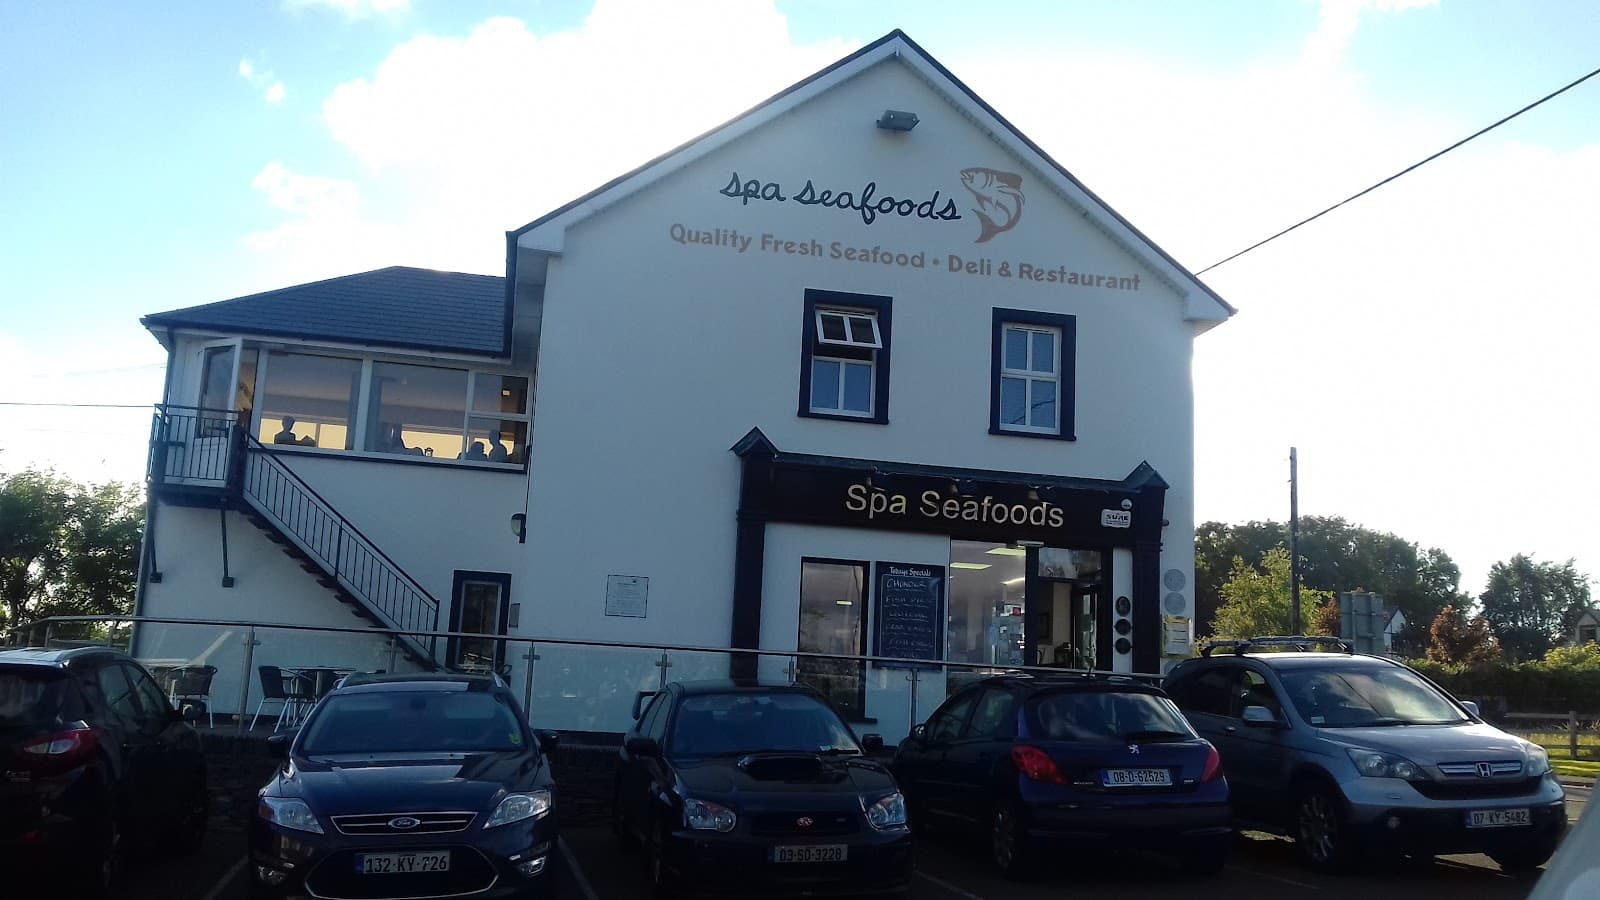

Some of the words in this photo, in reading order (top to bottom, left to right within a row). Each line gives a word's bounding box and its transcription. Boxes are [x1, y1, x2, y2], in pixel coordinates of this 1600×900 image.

[719, 171, 786, 204] spa
[792, 179, 962, 224] seafoods
[669, 223, 752, 254] Quality
[760, 232, 823, 257] Fresh
[829, 241, 925, 269] Seafood
[947, 254, 991, 277] Deli
[998, 262, 1012, 278] &
[1018, 263, 1141, 291] Restaurant
[845, 483, 907, 519] Spa
[919, 490, 1064, 528] Seafoods
